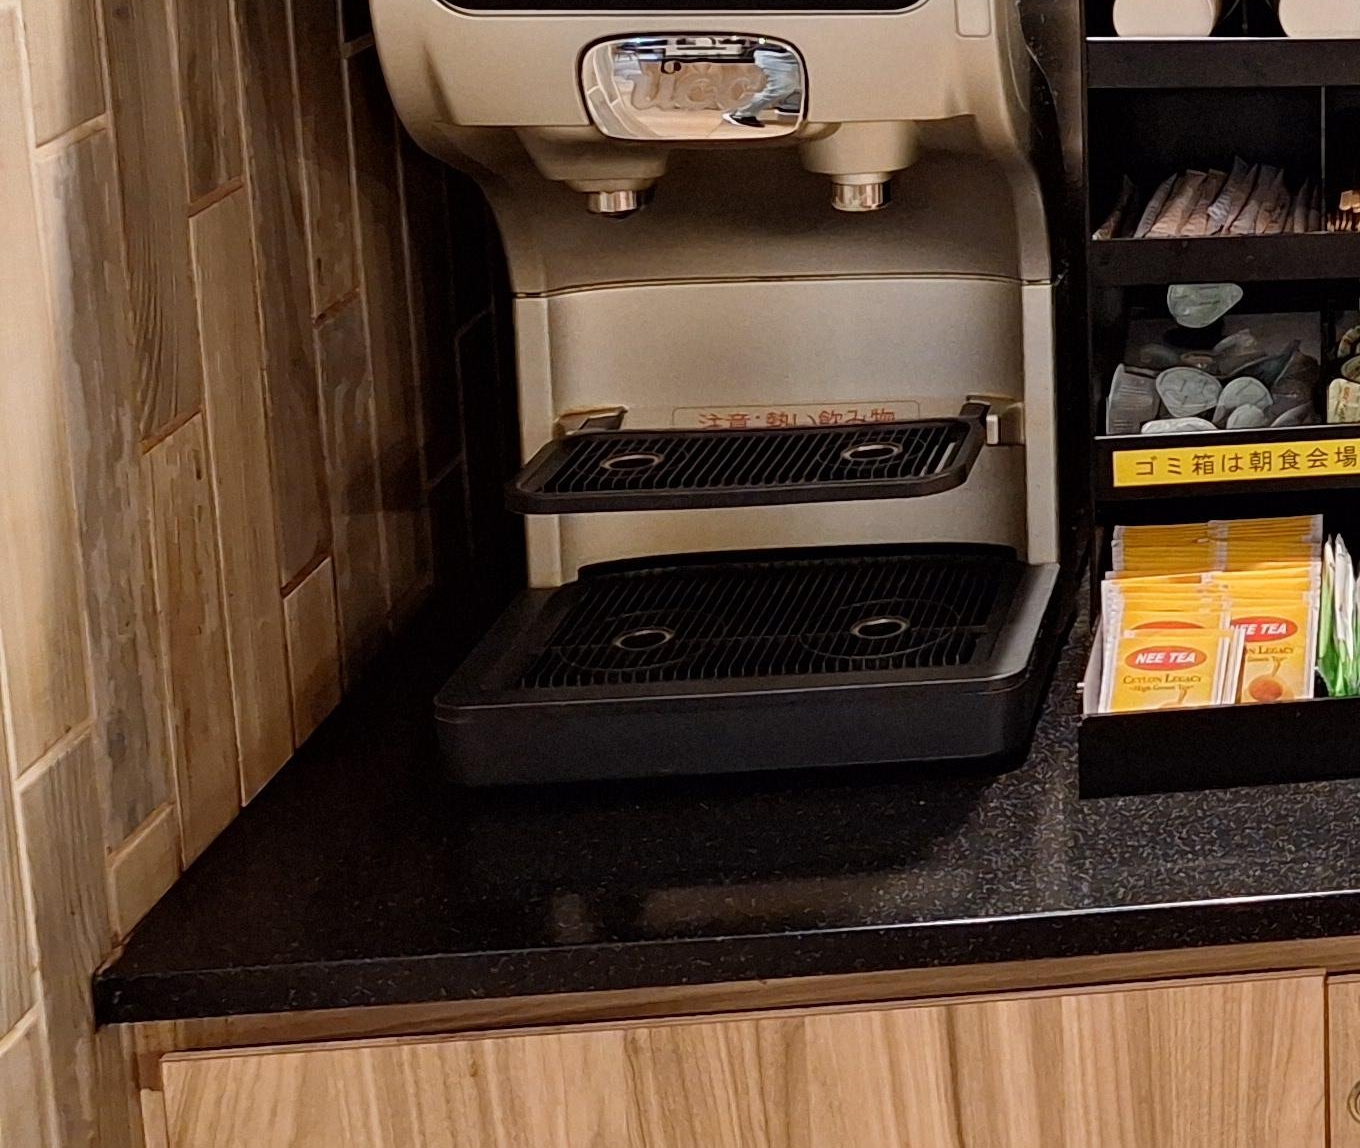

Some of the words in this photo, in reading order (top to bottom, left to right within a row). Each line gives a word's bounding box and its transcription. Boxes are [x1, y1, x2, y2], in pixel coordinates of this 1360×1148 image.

[1261, 622, 1287, 635] TEA
[1135, 652, 1165, 664] NEE
[1169, 652, 1196, 663] TEA
